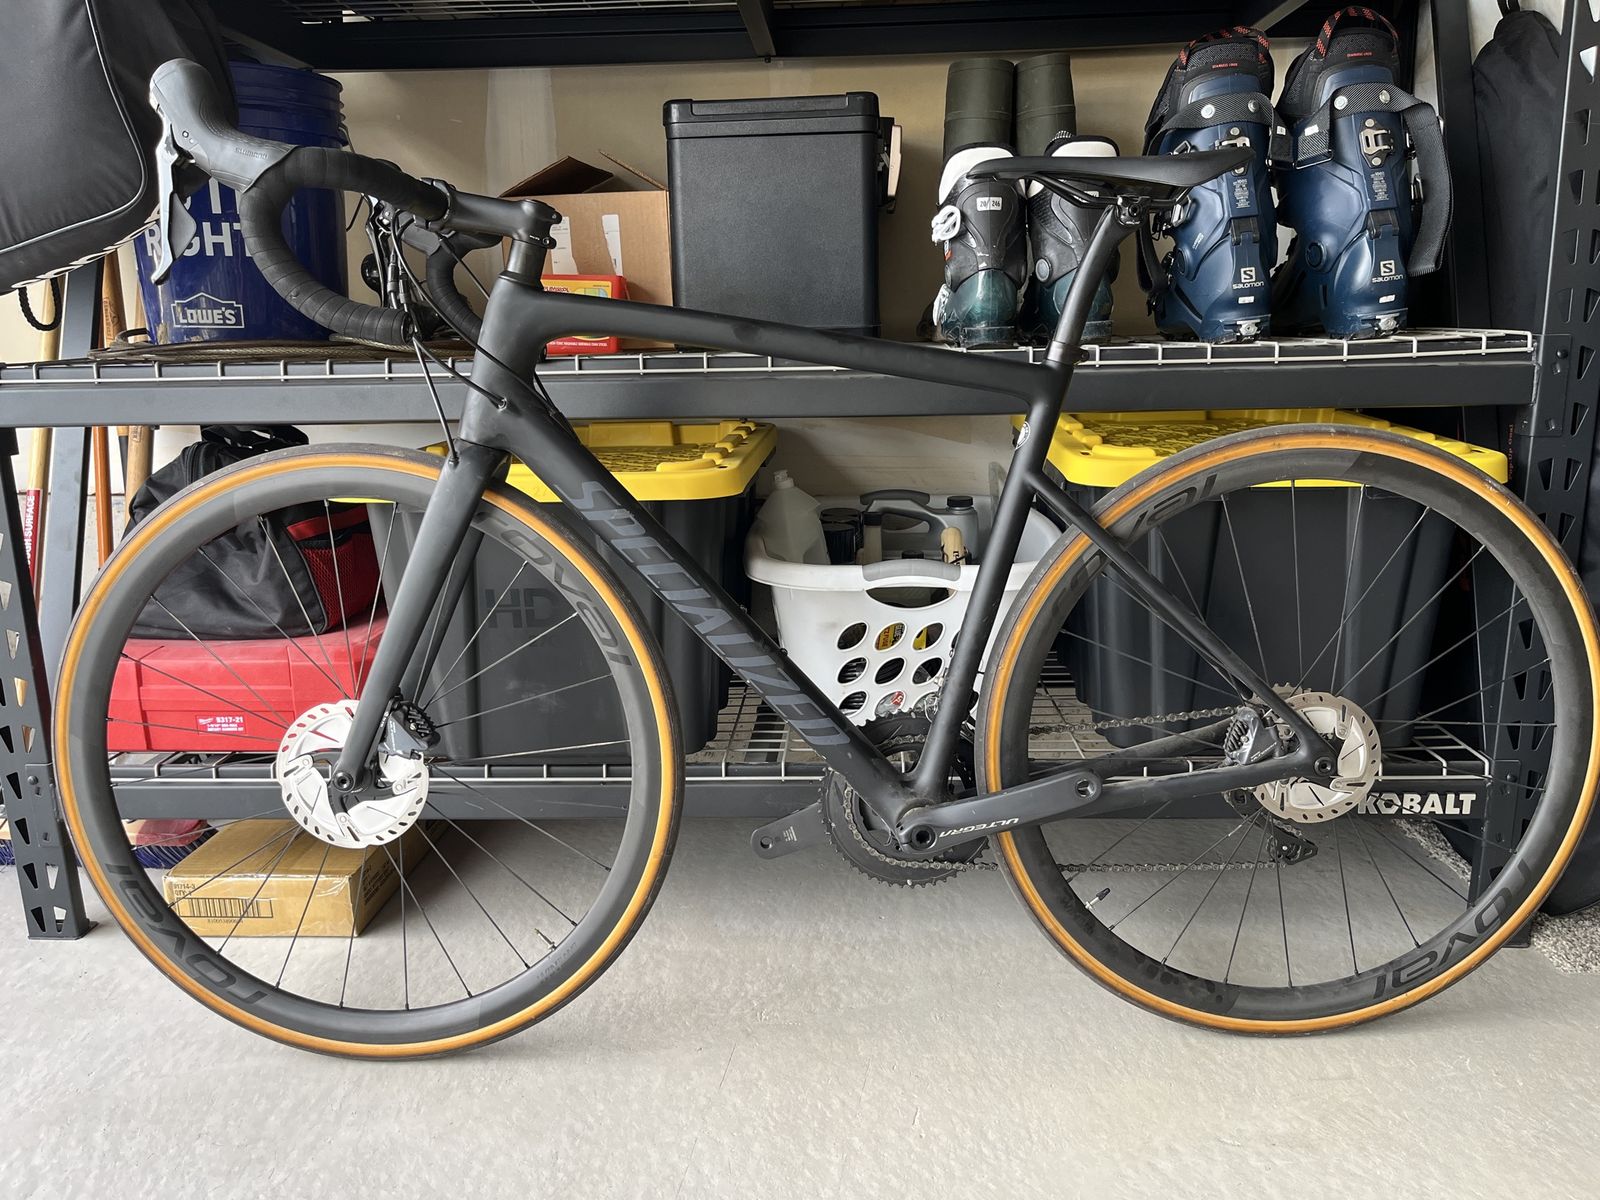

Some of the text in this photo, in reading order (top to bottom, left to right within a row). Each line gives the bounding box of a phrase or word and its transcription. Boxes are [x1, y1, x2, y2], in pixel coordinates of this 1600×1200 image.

[178, 307, 237, 325] LOWE'S
[24, 495, 35, 537] SURFACE
[1357, 792, 1477, 815] KOBALT
[938, 817, 1020, 839] ULTEGRA
